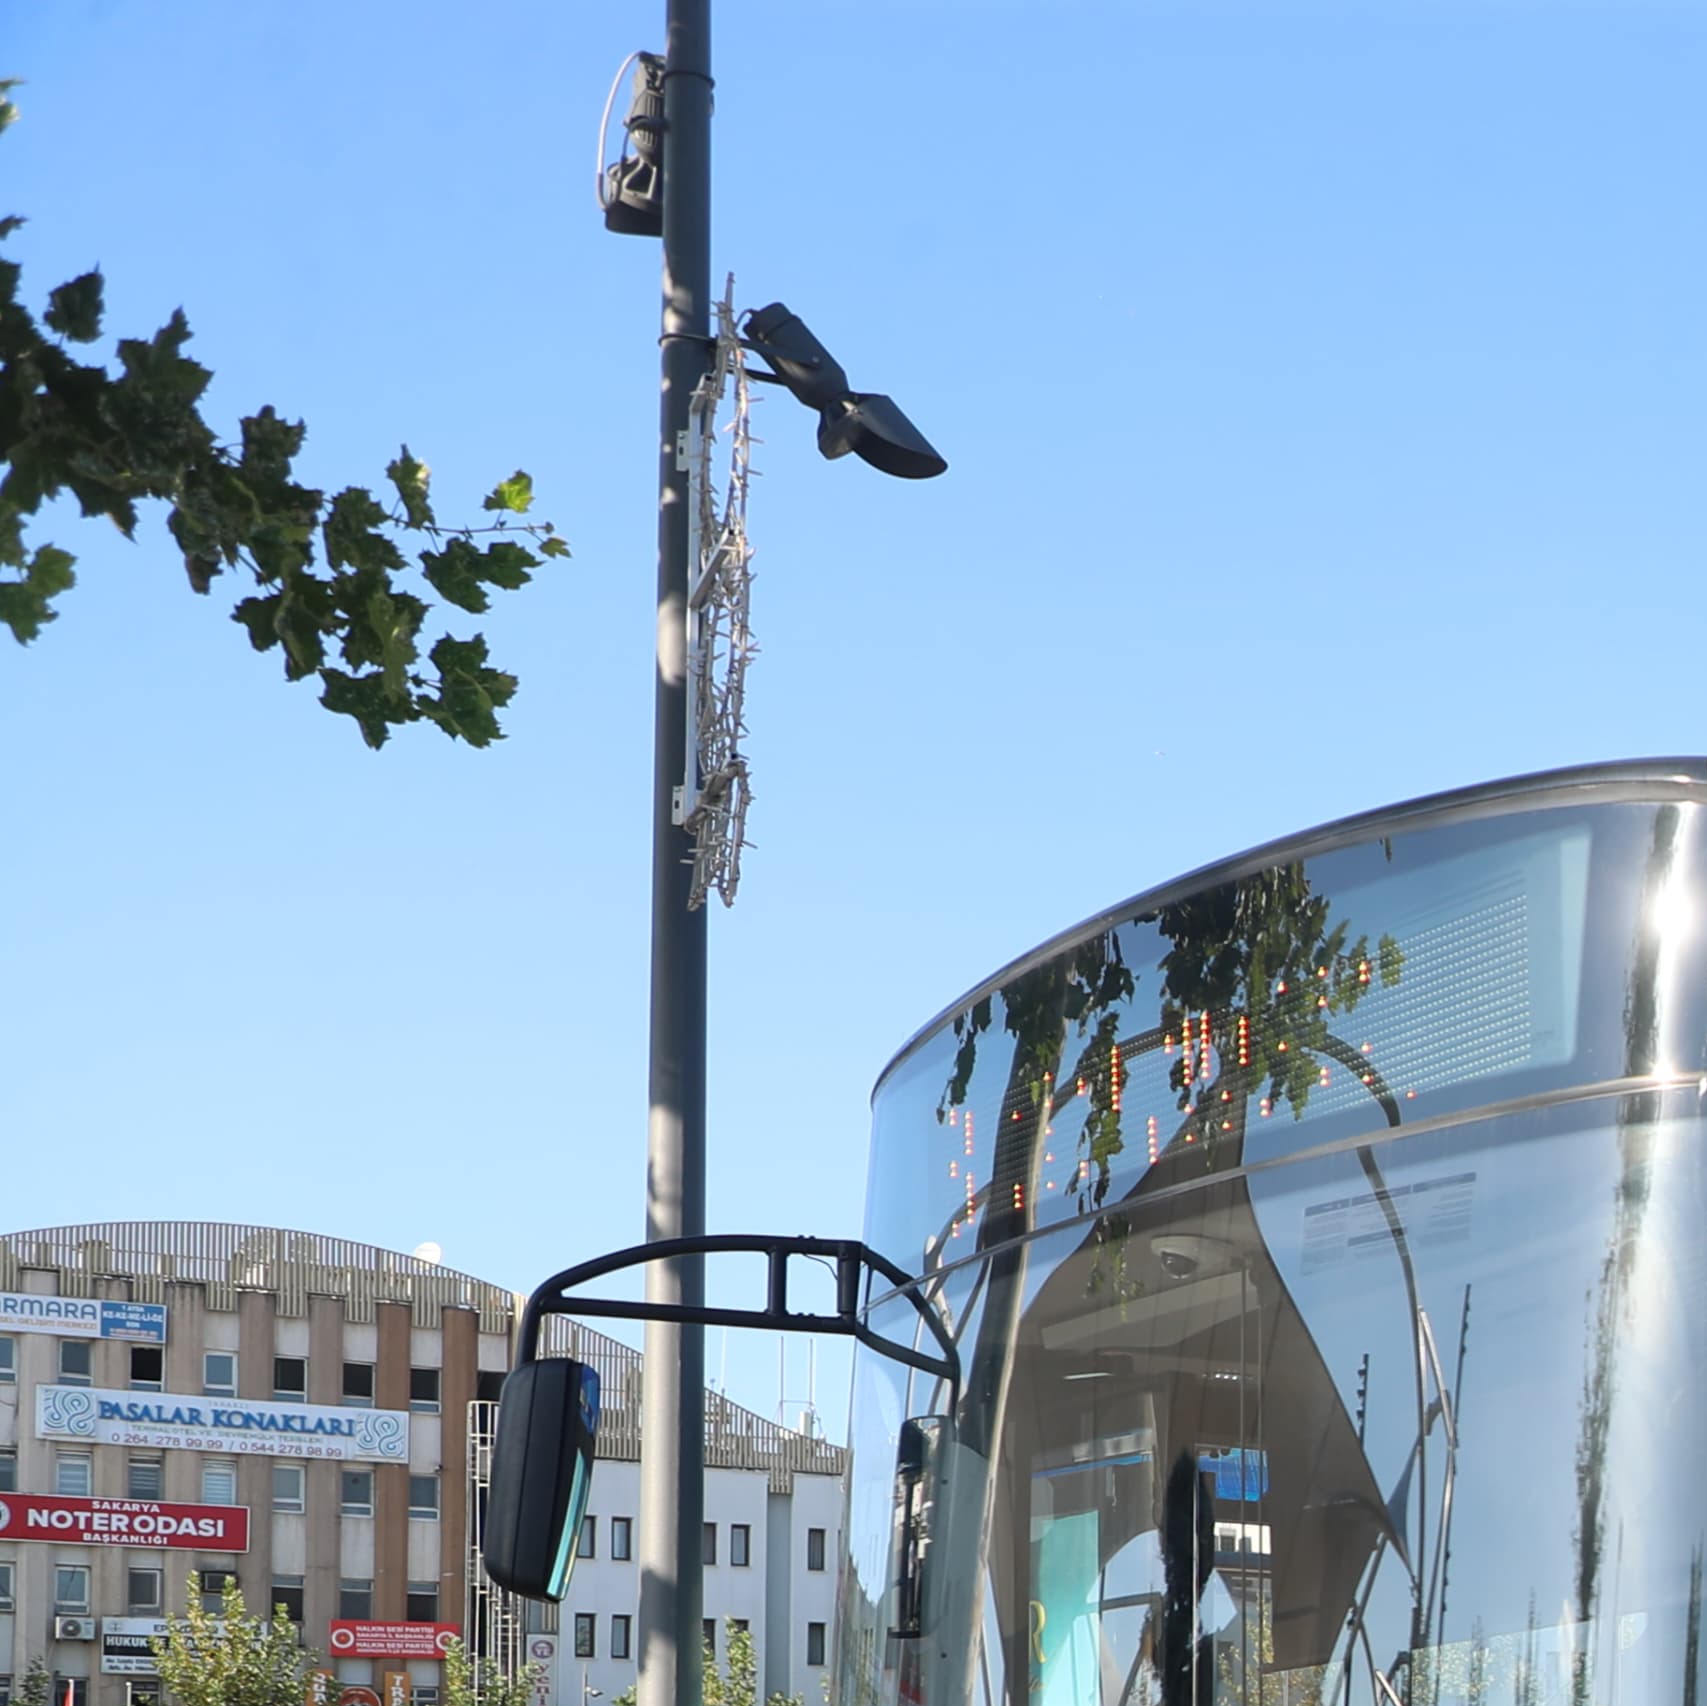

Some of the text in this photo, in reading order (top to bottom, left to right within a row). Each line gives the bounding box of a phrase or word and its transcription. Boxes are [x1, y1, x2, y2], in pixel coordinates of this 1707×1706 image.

[0, 1297, 97, 1320] RMARA
[211, 1409, 356, 1437] KONAKLARI
[111, 1433, 120, 1442] 0
[123, 1433, 149, 1444] 264
[156, 1436, 180, 1447] 278
[206, 1439, 223, 1449] 99
[251, 1442, 274, 1453] 544
[326, 1447, 342, 1458] 99
[92, 1500, 160, 1513] SAKARYA
[27, 1508, 224, 1537] NOTER ODASI
[82, 1533, 168, 1545] BAŞKANLIĞI
[106, 1636, 148, 1648] HUKUK
